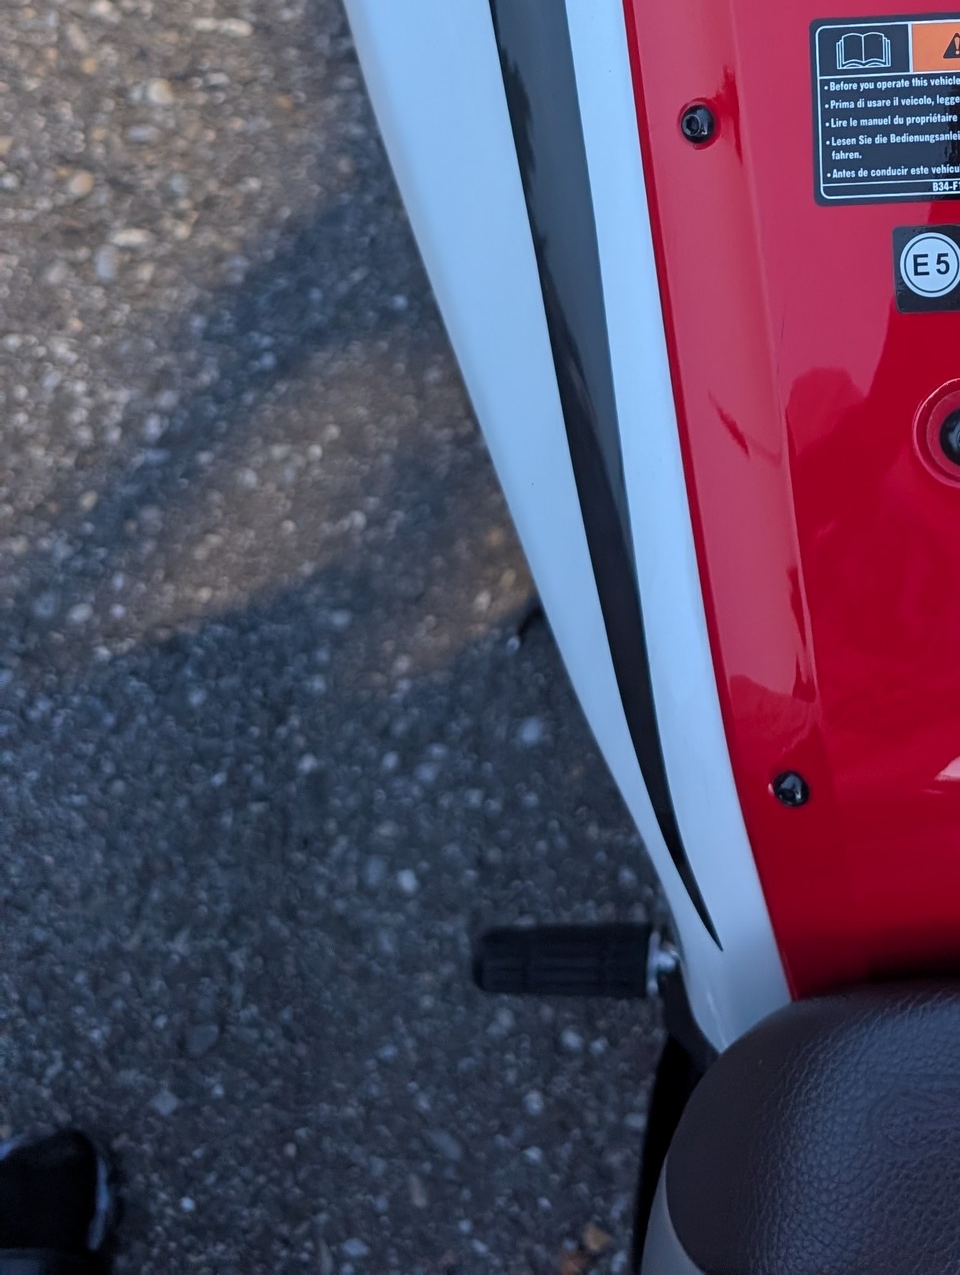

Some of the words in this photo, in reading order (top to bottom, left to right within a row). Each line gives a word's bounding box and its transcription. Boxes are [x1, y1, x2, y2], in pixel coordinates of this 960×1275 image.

[830, 81, 858, 91] Before
[860, 82, 874, 92] you
[876, 79, 910, 91] operate
[911, 77, 928, 87] this
[830, 99, 855, 109] Prima
[857, 98, 865, 108] di
[867, 99, 891, 107] usare
[893, 97, 899, 106] il
[901, 95, 934, 106] veicolo,
[831, 118, 848, 128] Lire
[850, 117, 858, 127] le
[860, 115, 891, 126] manuel
[893, 115, 904, 125] du
[906, 113, 958, 126] propriétaire
[831, 137, 856, 146] Lesen
[858, 135, 872, 145] Sie
[874, 134, 888, 144] die
[831, 150, 862, 160] fahren.
[832, 169, 856, 178] Antes
[858, 168, 868, 177] de
[870, 165, 908, 177] conducir
[910, 165, 929, 175] este
